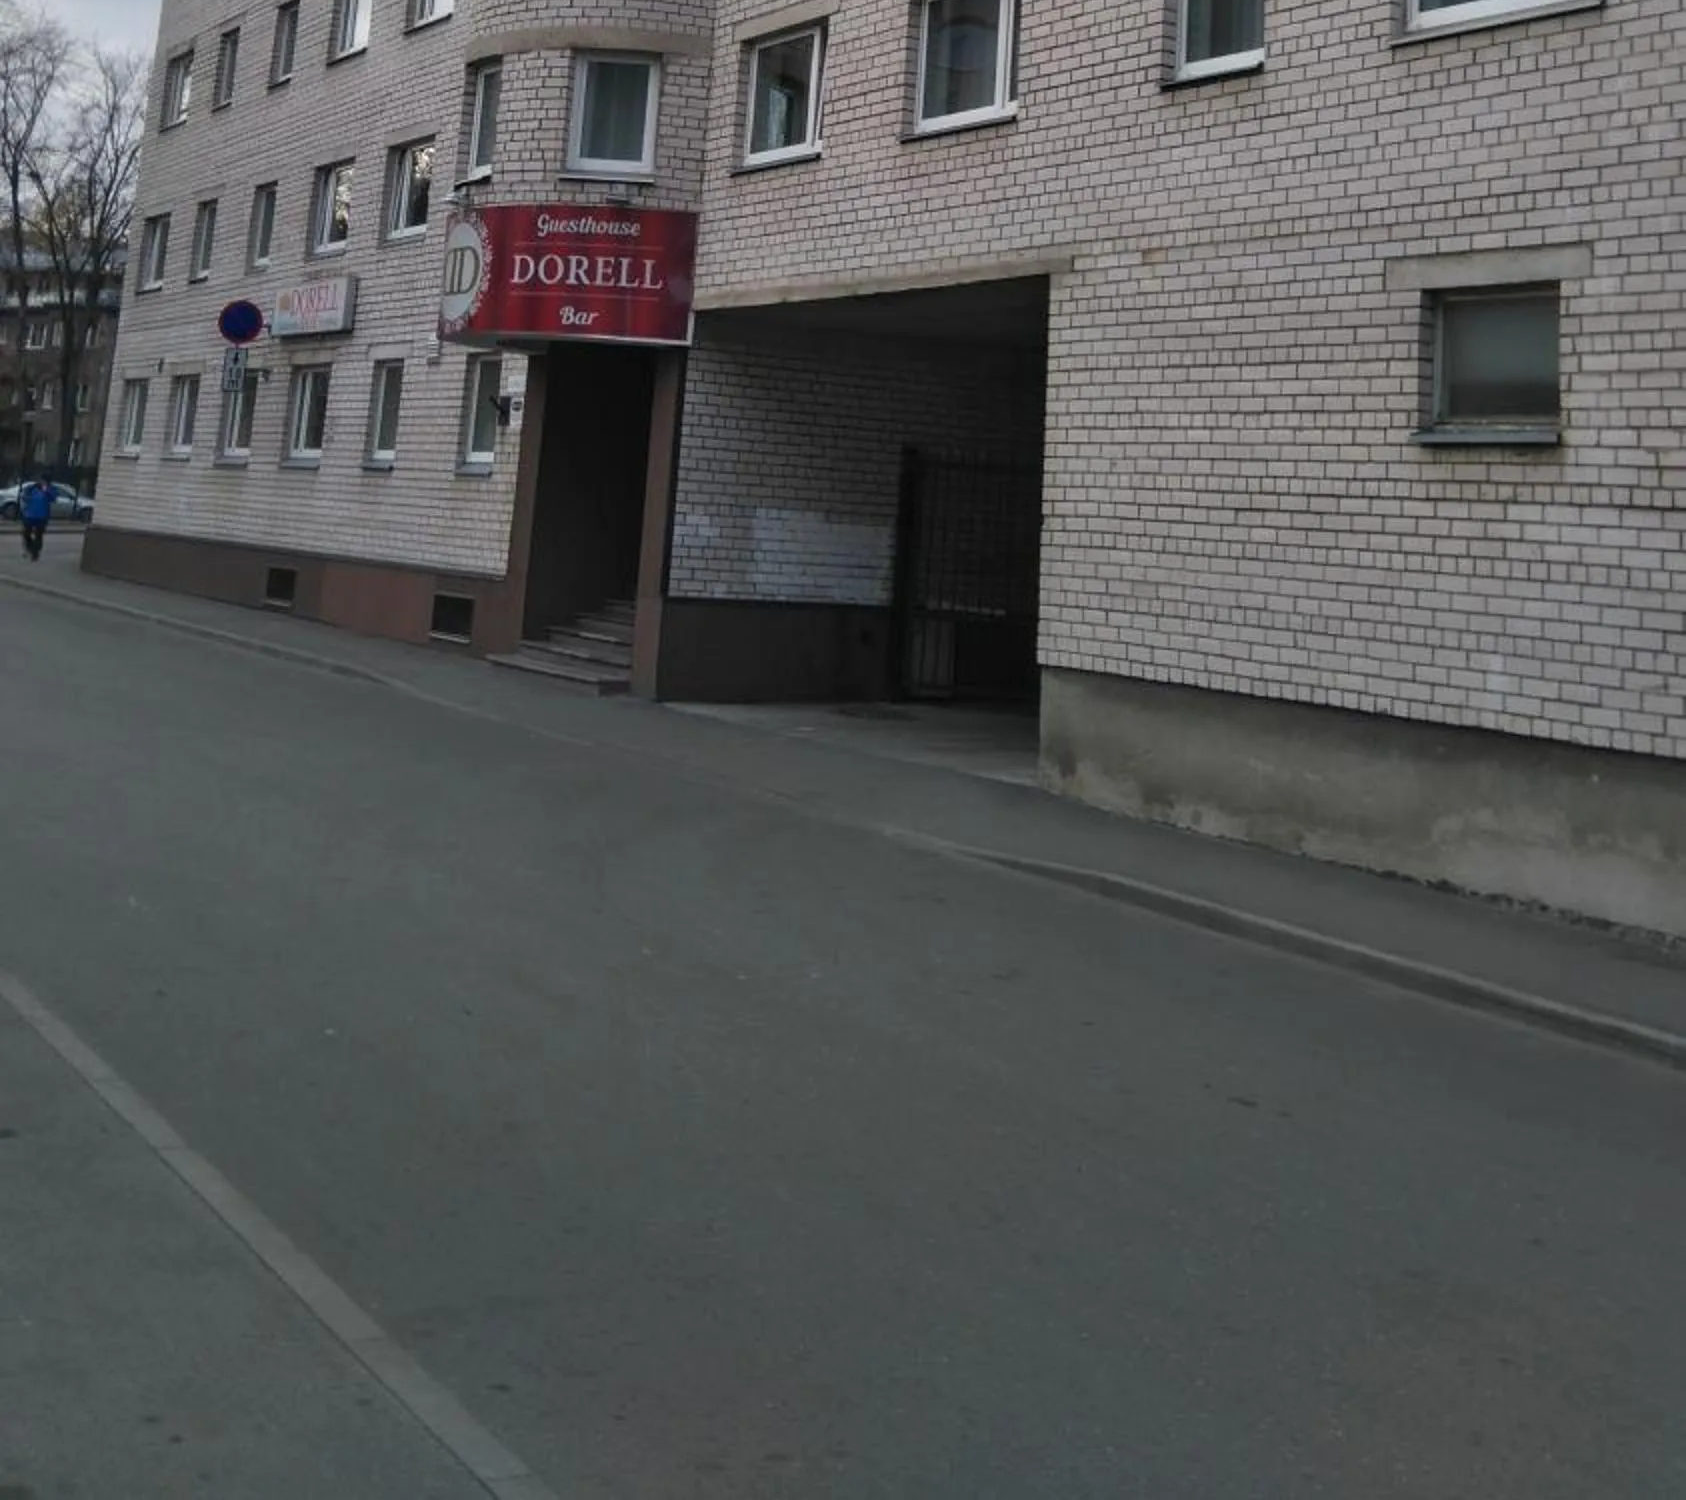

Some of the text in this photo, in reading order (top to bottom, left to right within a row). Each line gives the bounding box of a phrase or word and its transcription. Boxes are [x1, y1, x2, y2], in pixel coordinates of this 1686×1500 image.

[536, 213, 641, 238] Guesthouse
[509, 253, 663, 290] DORELL
[559, 305, 600, 325] Bar
